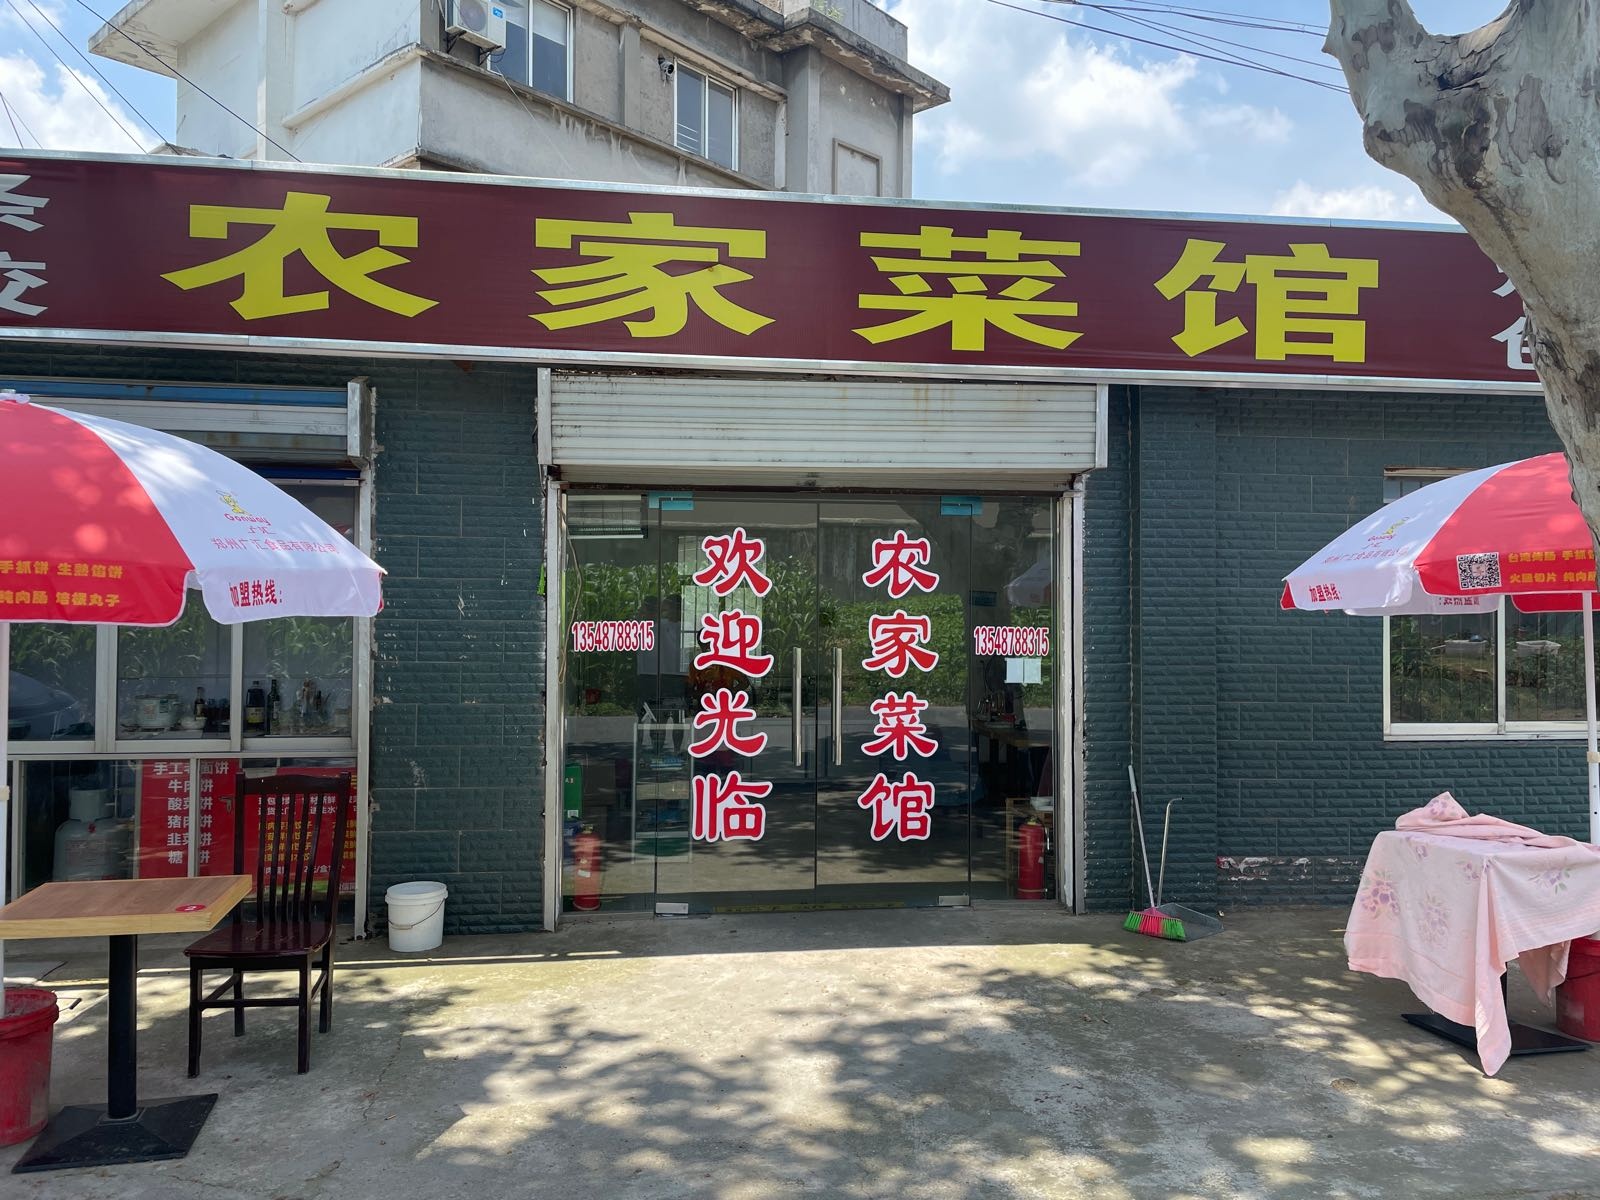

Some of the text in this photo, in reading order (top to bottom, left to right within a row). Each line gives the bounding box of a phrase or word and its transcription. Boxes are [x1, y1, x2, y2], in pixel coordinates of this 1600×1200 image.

[162, 191, 1380, 364] 农家菜馆
[0, 560, 49, 574] 手抓饼
[572, 621, 655, 652] 13548788315
[691, 530, 773, 841] 欢迎光临
[860, 532, 938, 841] 农家菜馆
[974, 626, 1050, 656] 13548788315
